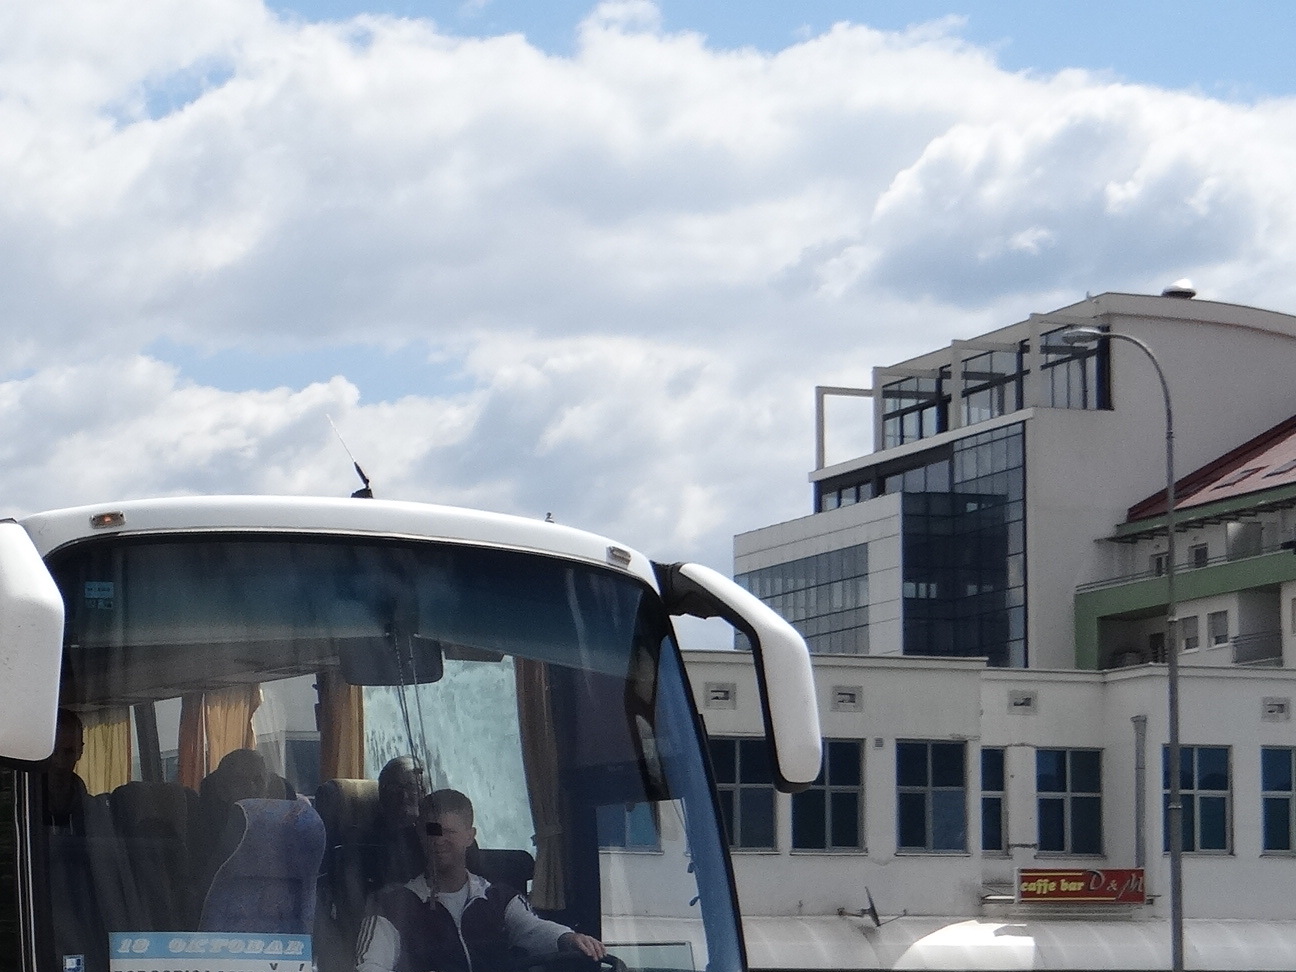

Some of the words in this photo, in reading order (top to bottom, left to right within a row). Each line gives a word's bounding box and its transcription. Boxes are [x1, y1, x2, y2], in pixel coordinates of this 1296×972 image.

[1020, 879, 1056, 894] caffe
[1060, 879, 1084, 891] bar
[1107, 880, 1117, 891] &
[168, 938, 305, 955] OKTOBAR
